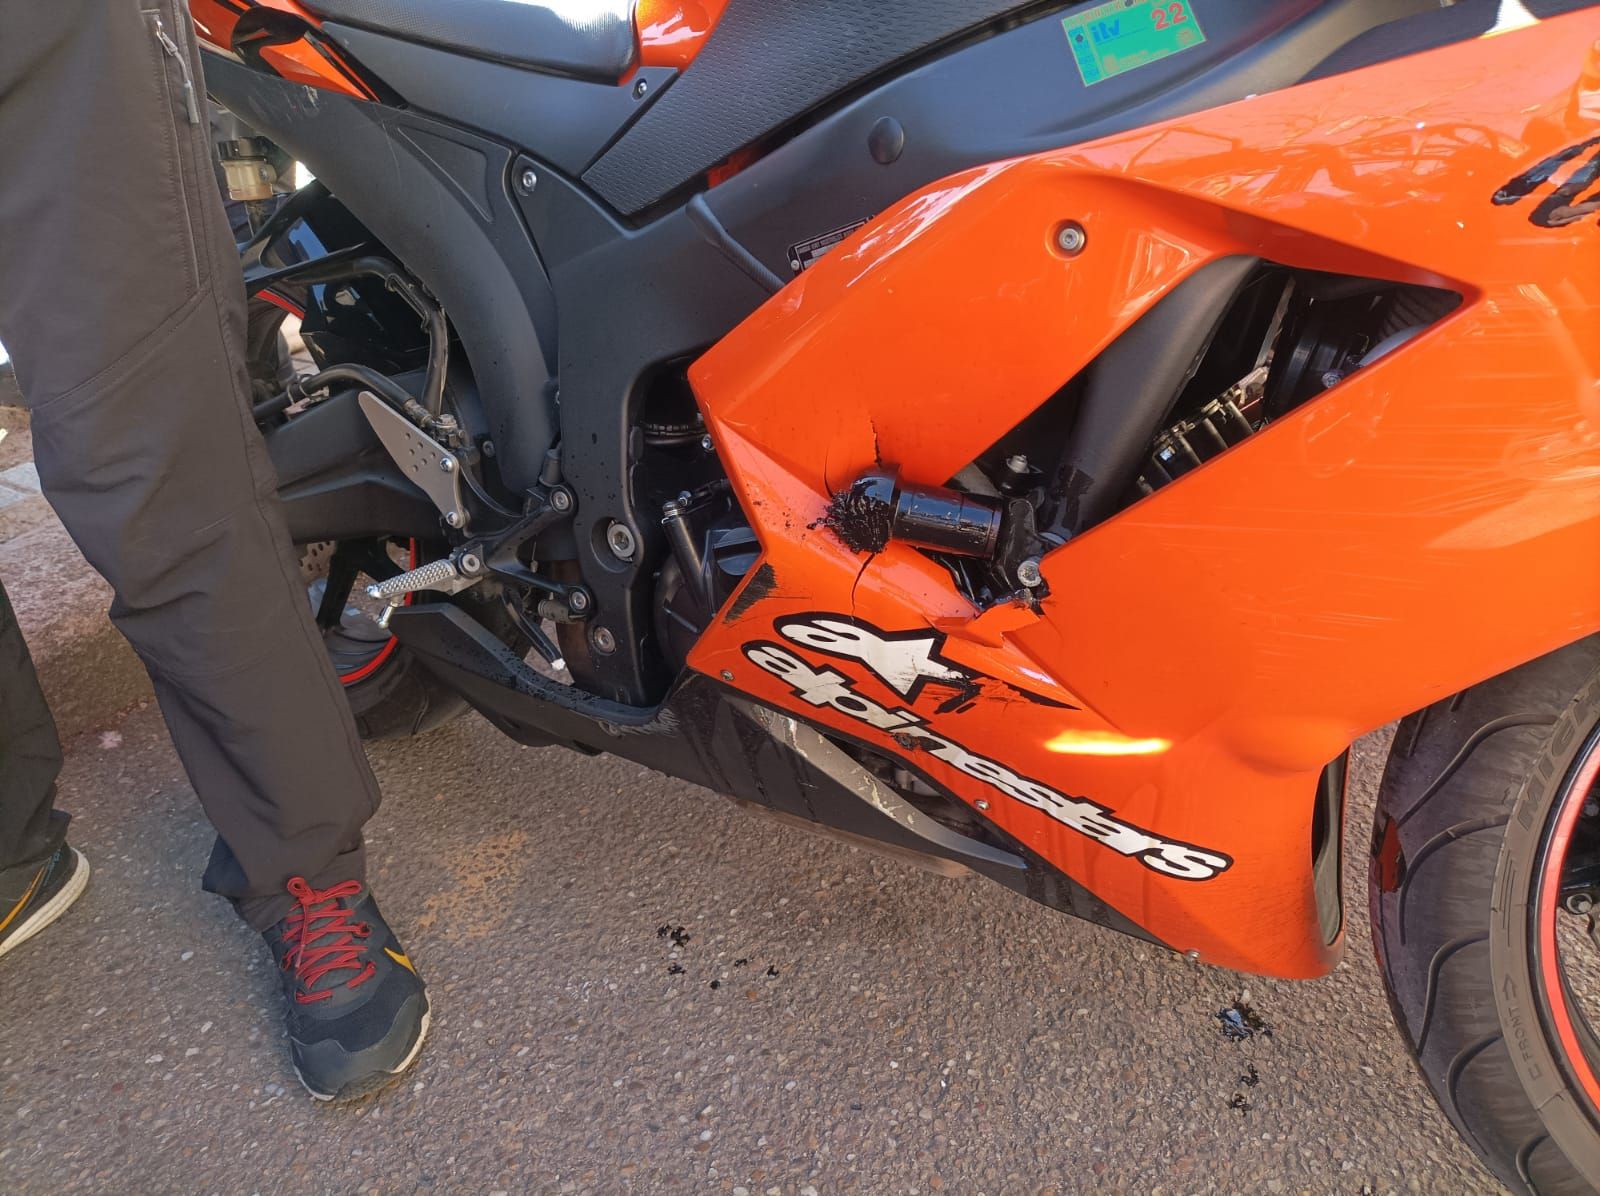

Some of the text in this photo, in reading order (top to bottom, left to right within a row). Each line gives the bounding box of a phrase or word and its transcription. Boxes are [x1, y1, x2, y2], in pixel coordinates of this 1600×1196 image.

[1151, 2, 1188, 31] 22
[744, 643, 1231, 880] alpinestars
[1507, 1004, 1534, 1063] FRONT
